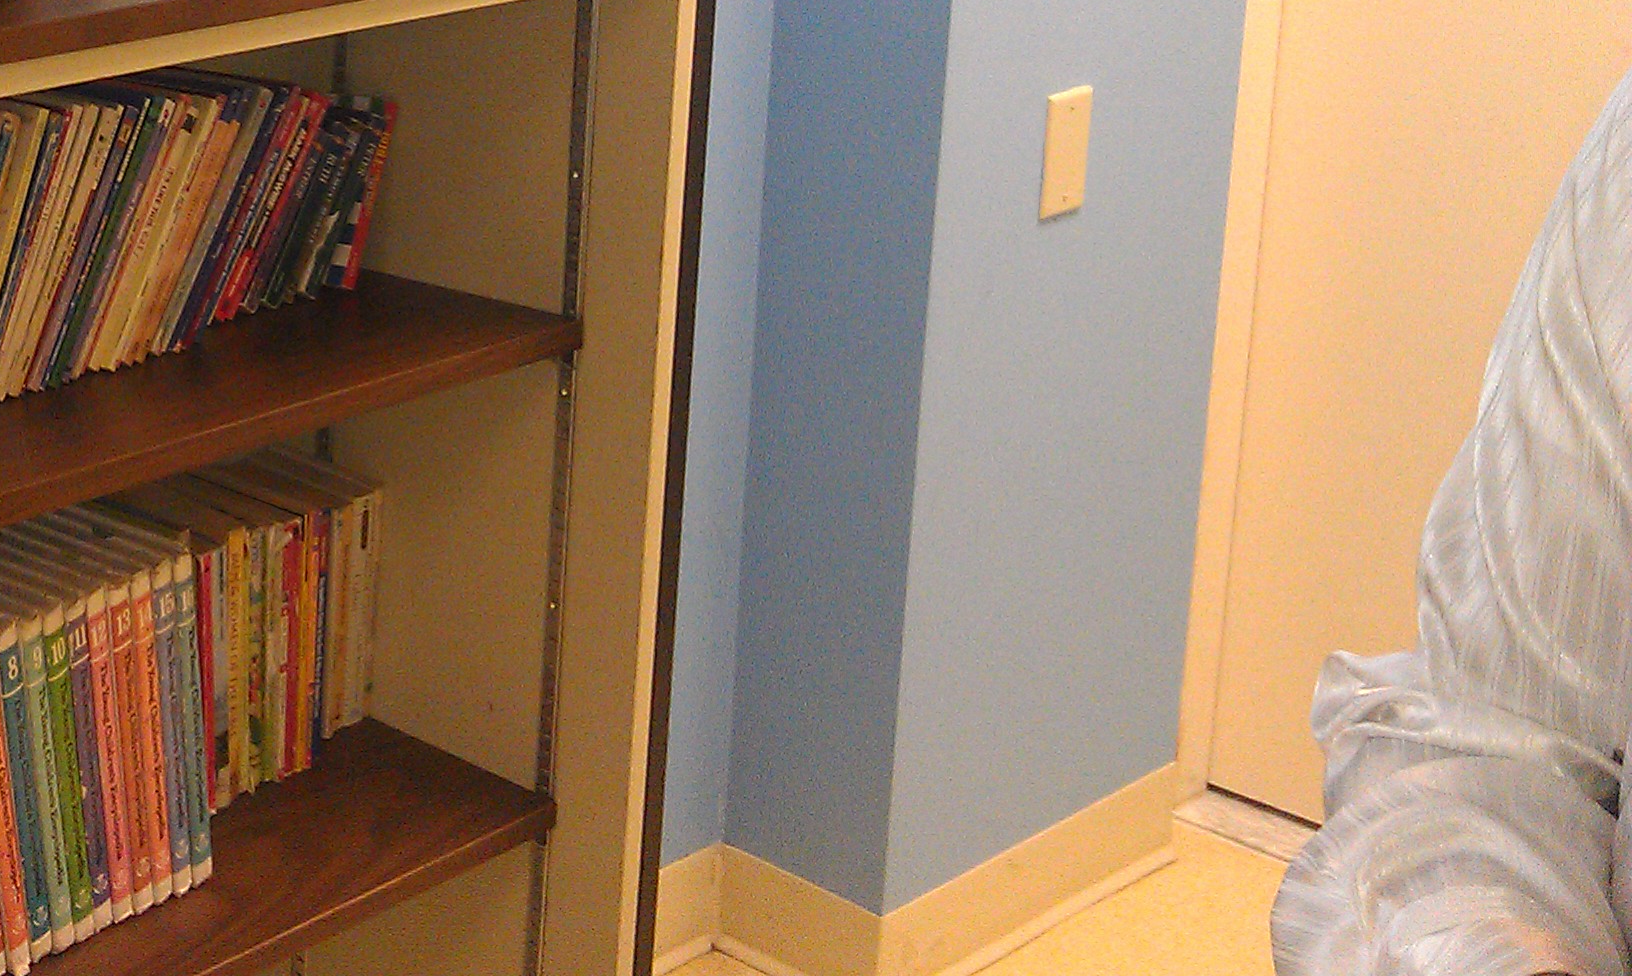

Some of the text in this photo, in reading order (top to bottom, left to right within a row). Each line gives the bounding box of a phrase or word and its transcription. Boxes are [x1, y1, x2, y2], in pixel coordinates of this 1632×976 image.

[92, 619, 108, 639] 12
[117, 608, 131, 636] 13
[32, 647, 43, 668] 9
[51, 640, 65, 662] 10
[7, 655, 18, 680] 8
